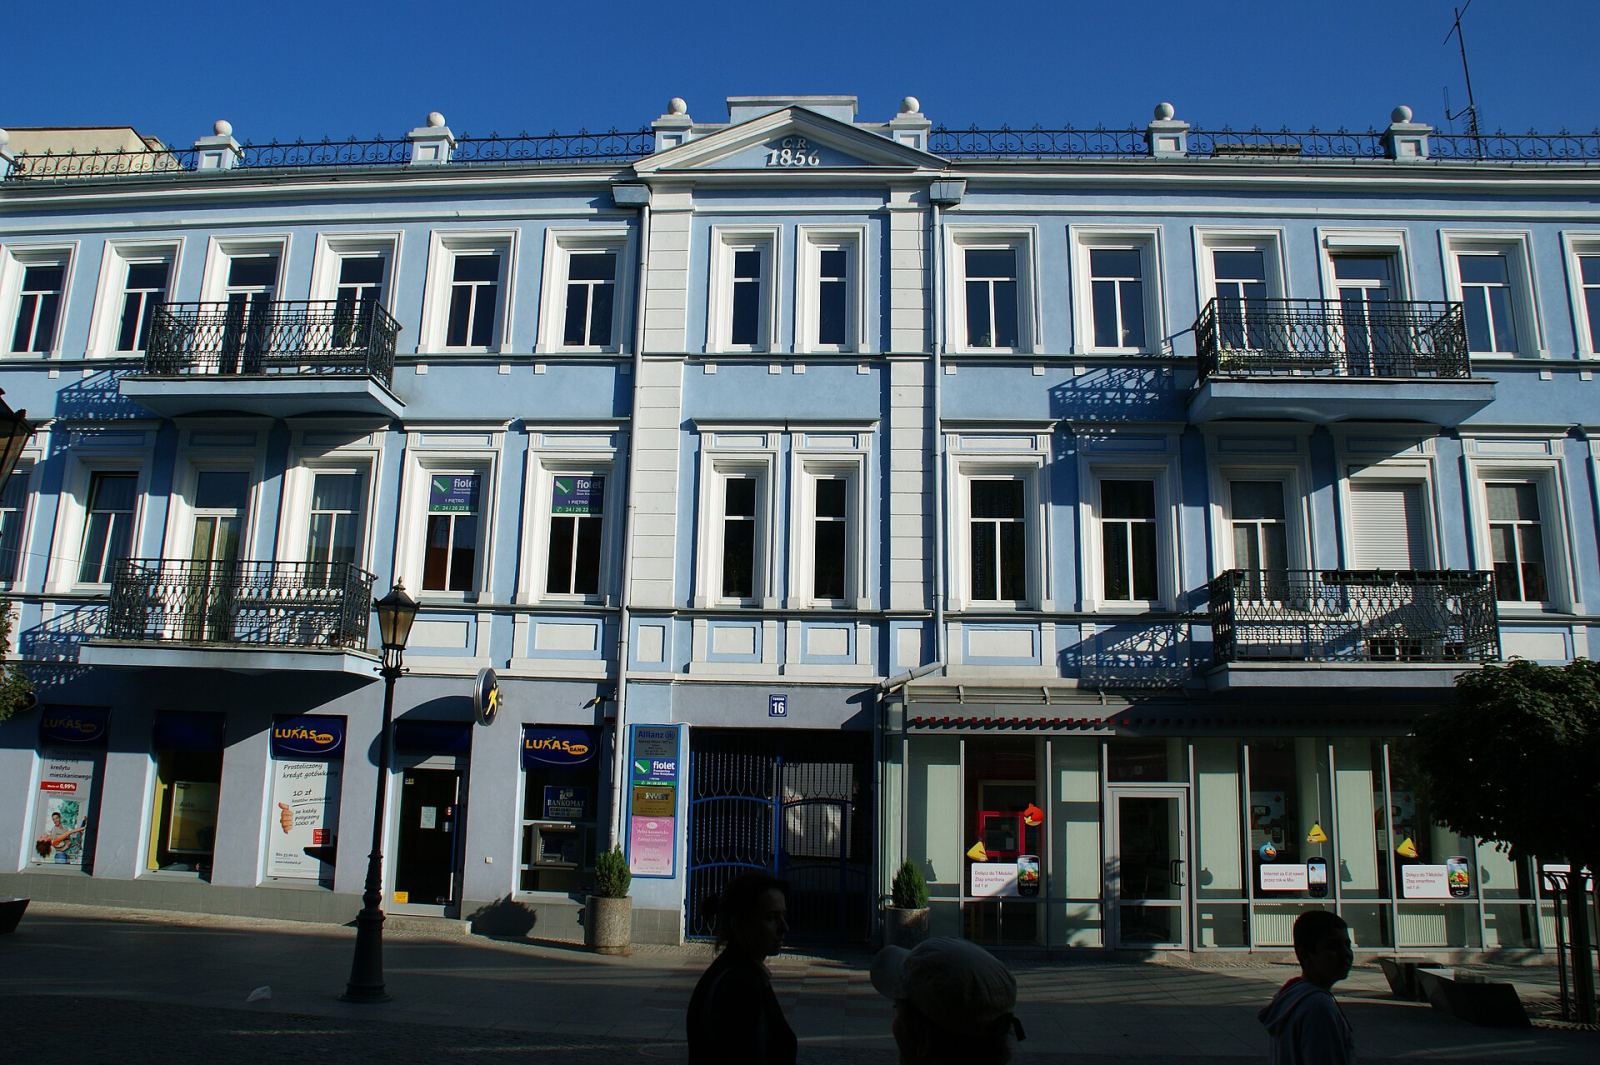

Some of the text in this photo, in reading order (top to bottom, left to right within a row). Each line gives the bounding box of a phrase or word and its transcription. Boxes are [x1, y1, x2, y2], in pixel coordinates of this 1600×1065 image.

[767, 148, 820, 166] 1856
[576, 479, 602, 489] fiolet
[772, 701, 785, 714] 16
[43, 719, 81, 729] LUKAS
[274, 727, 317, 740] LUKAS
[638, 730, 665, 739] Allianz
[525, 738, 570, 750] LUKAS
[653, 761, 676, 770] fiolet
